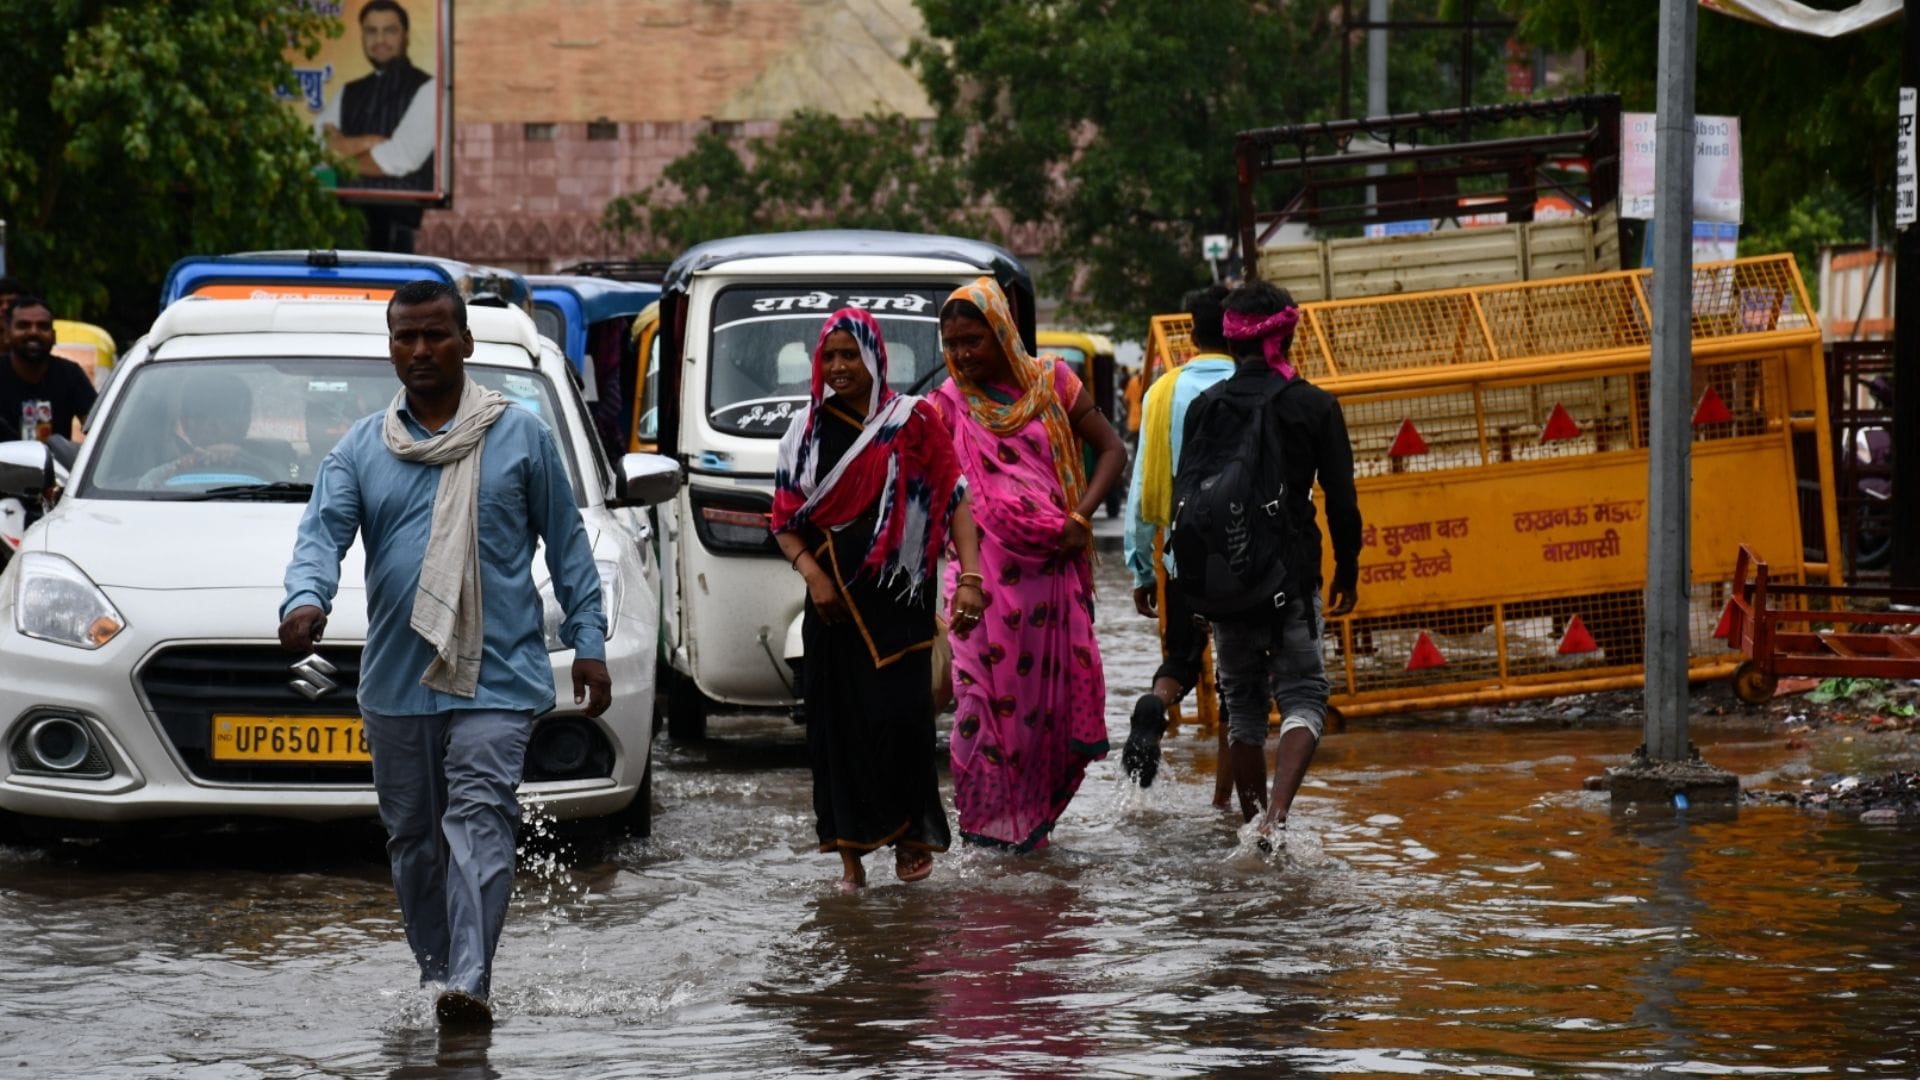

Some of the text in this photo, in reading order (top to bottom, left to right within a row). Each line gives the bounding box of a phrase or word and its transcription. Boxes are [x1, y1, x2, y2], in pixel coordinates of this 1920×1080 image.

[752, 291, 933, 313] राधे राधे
[1513, 504, 1589, 533] लखनऊ
[1380, 521, 1432, 557] सुरक्षा
[1435, 516, 1470, 539] बल
[1410, 548, 1452, 578] रेलवे
[236, 726, 368, 754] UP65QT18
